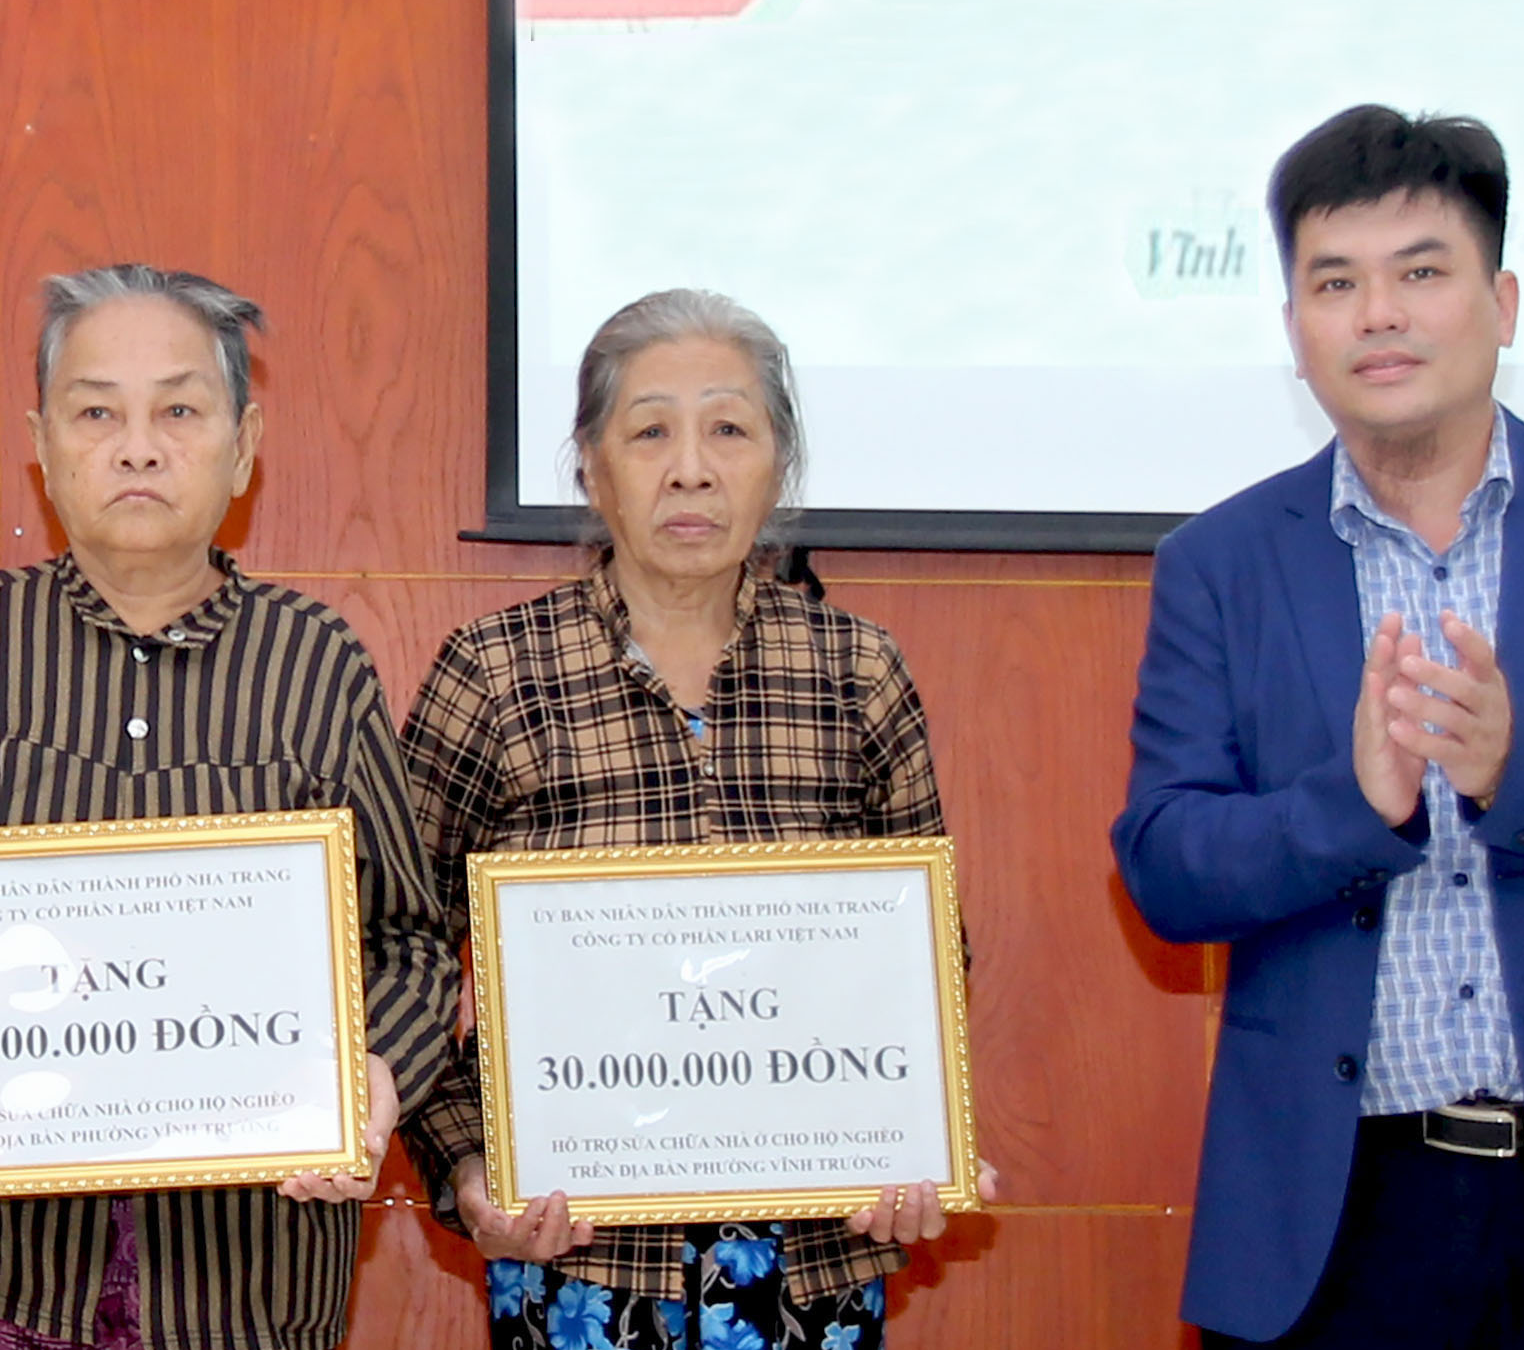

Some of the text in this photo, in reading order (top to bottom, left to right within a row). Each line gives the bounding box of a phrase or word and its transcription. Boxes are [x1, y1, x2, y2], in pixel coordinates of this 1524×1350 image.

[1145, 227, 1246, 281] Vĩnh
[37, 879, 73, 896] DÂN
[79, 875, 139, 892] THÀNH
[146, 872, 182, 889] PHỐ
[187, 873, 224, 886] NHA
[229, 868, 291, 884] TRANG
[8, 908, 30, 921] TY
[119, 901, 160, 916] LARI
[166, 897, 208, 914] VIỆT
[213, 896, 253, 909] NAM
[561, 909, 595, 922] BAN
[601, 904, 647, 921] NHÂN
[652, 903, 687, 920] DÂN
[692, 902, 751, 918] THÀNH
[756, 901, 791, 916] PHỐ
[796, 903, 830, 915] NHA
[835, 900, 894, 914] TRANG
[571, 931, 621, 948] CÔNG
[626, 933, 645, 945] TY
[732, 929, 772, 943] LARI
[777, 927, 815, 944] VIỆT
[820, 927, 859, 940] NAM
[41, 956, 169, 1001] TẶNG
[659, 985, 780, 1030] TẶNG
[151, 1004, 302, 1052] ĐỒNG
[538, 1037, 909, 1092] 30.000.000 ĐỒNG
[95, 1099, 132, 1116] NHÀ
[137, 1097, 152, 1115] Ở
[155, 1098, 194, 1114] CHO
[200, 1095, 226, 1112] HỘ
[231, 1091, 295, 1109] NGHÈO
[71, 1125, 148, 1143] PHƯỜNG
[582, 1137, 618, 1154] TRỢ
[714, 1132, 750, 1148] NHÀ
[754, 1131, 767, 1147] Ở
[771, 1133, 809, 1146] CHO
[813, 1131, 838, 1146] HỘ
[842, 1128, 904, 1144] NGHÈO
[569, 1161, 615, 1179] TRÊN
[693, 1155, 765, 1175] PHƯỜNG
[770, 1156, 812, 1172] VĨNH
[816, 1155, 890, 1171] TRƯỜNG
